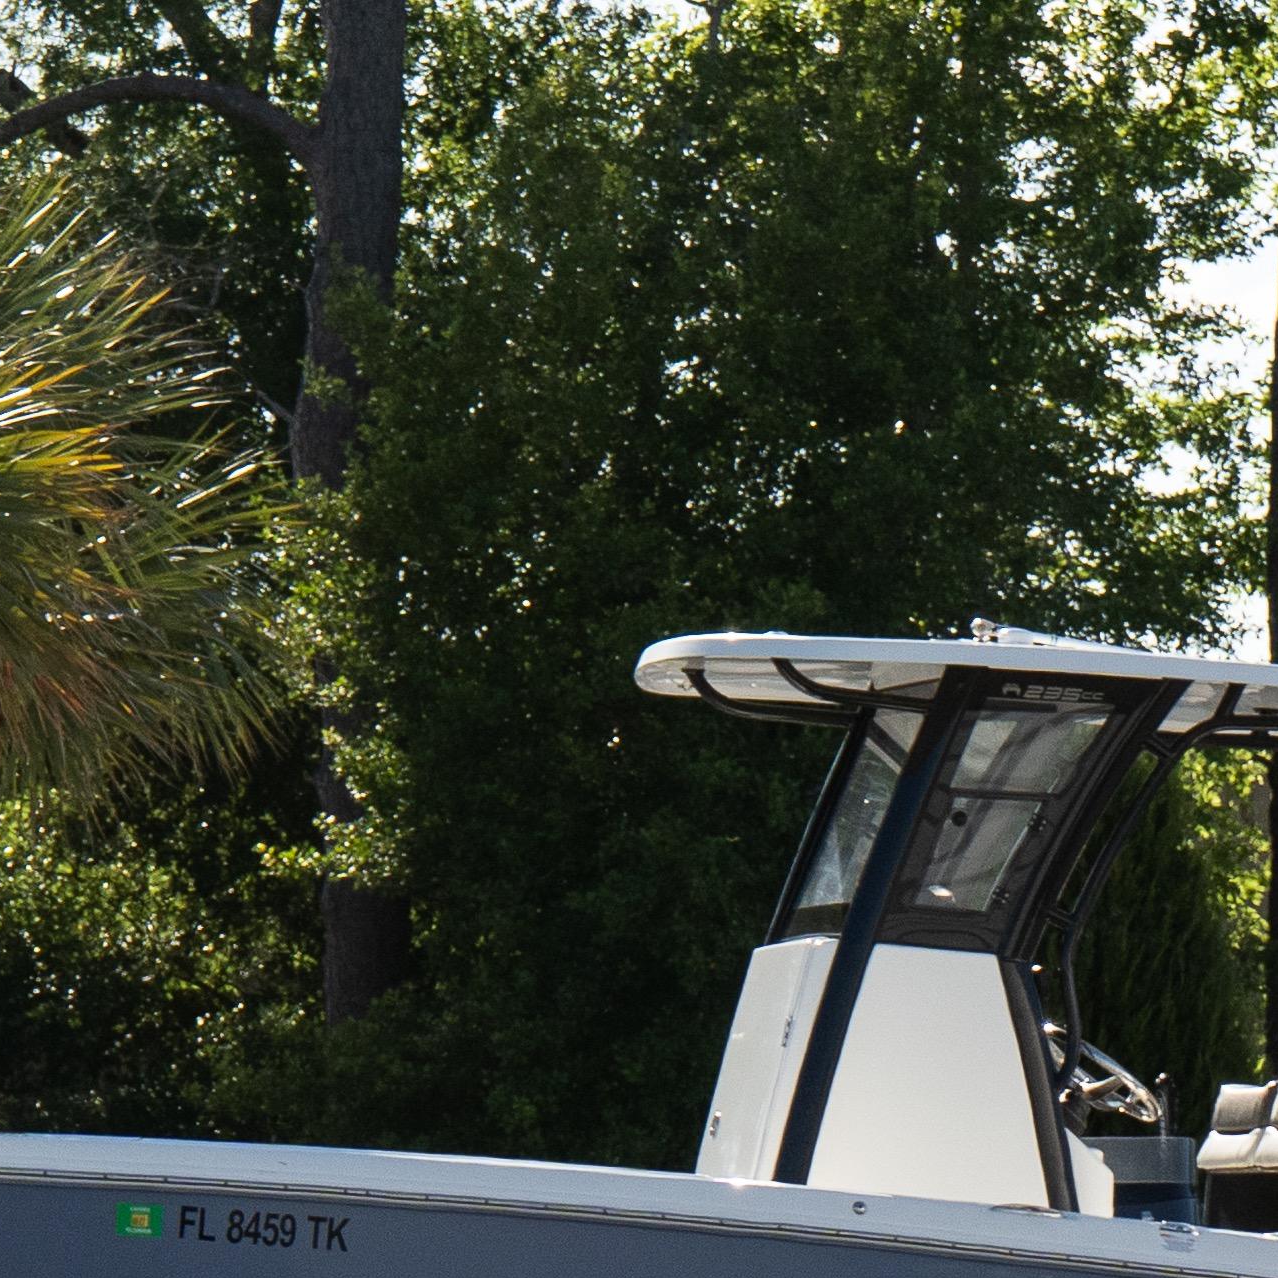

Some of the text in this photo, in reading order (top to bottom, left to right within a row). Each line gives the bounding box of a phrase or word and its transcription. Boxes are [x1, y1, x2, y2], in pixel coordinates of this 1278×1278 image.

[178, 1205, 350, 1251] FL 8459 TK
